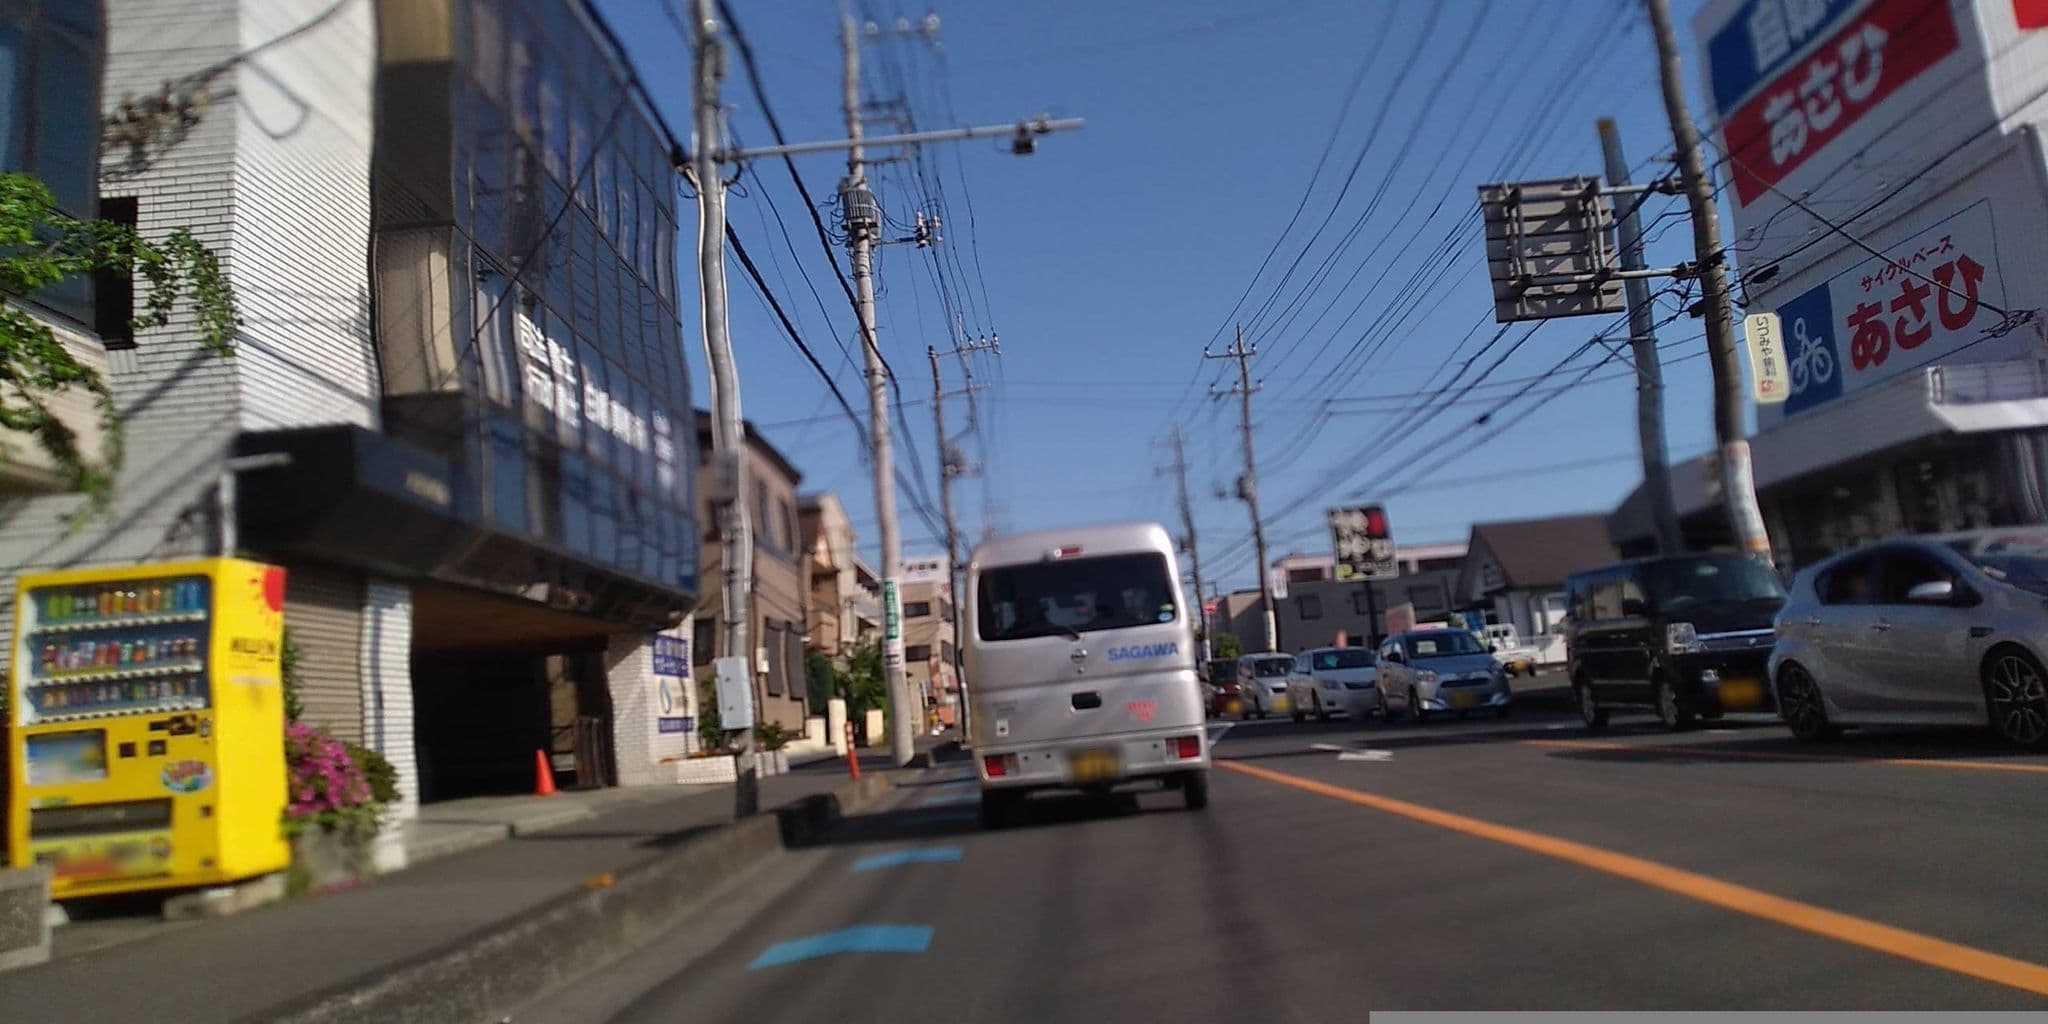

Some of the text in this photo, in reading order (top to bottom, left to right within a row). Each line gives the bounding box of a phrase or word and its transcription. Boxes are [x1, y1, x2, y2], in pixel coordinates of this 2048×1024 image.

[1763, 21, 1889, 166] あさひ
[1860, 234, 1955, 293] サイクルベース
[1846, 253, 1985, 371] あさひ
[1107, 641, 1179, 662] SAGAWA
